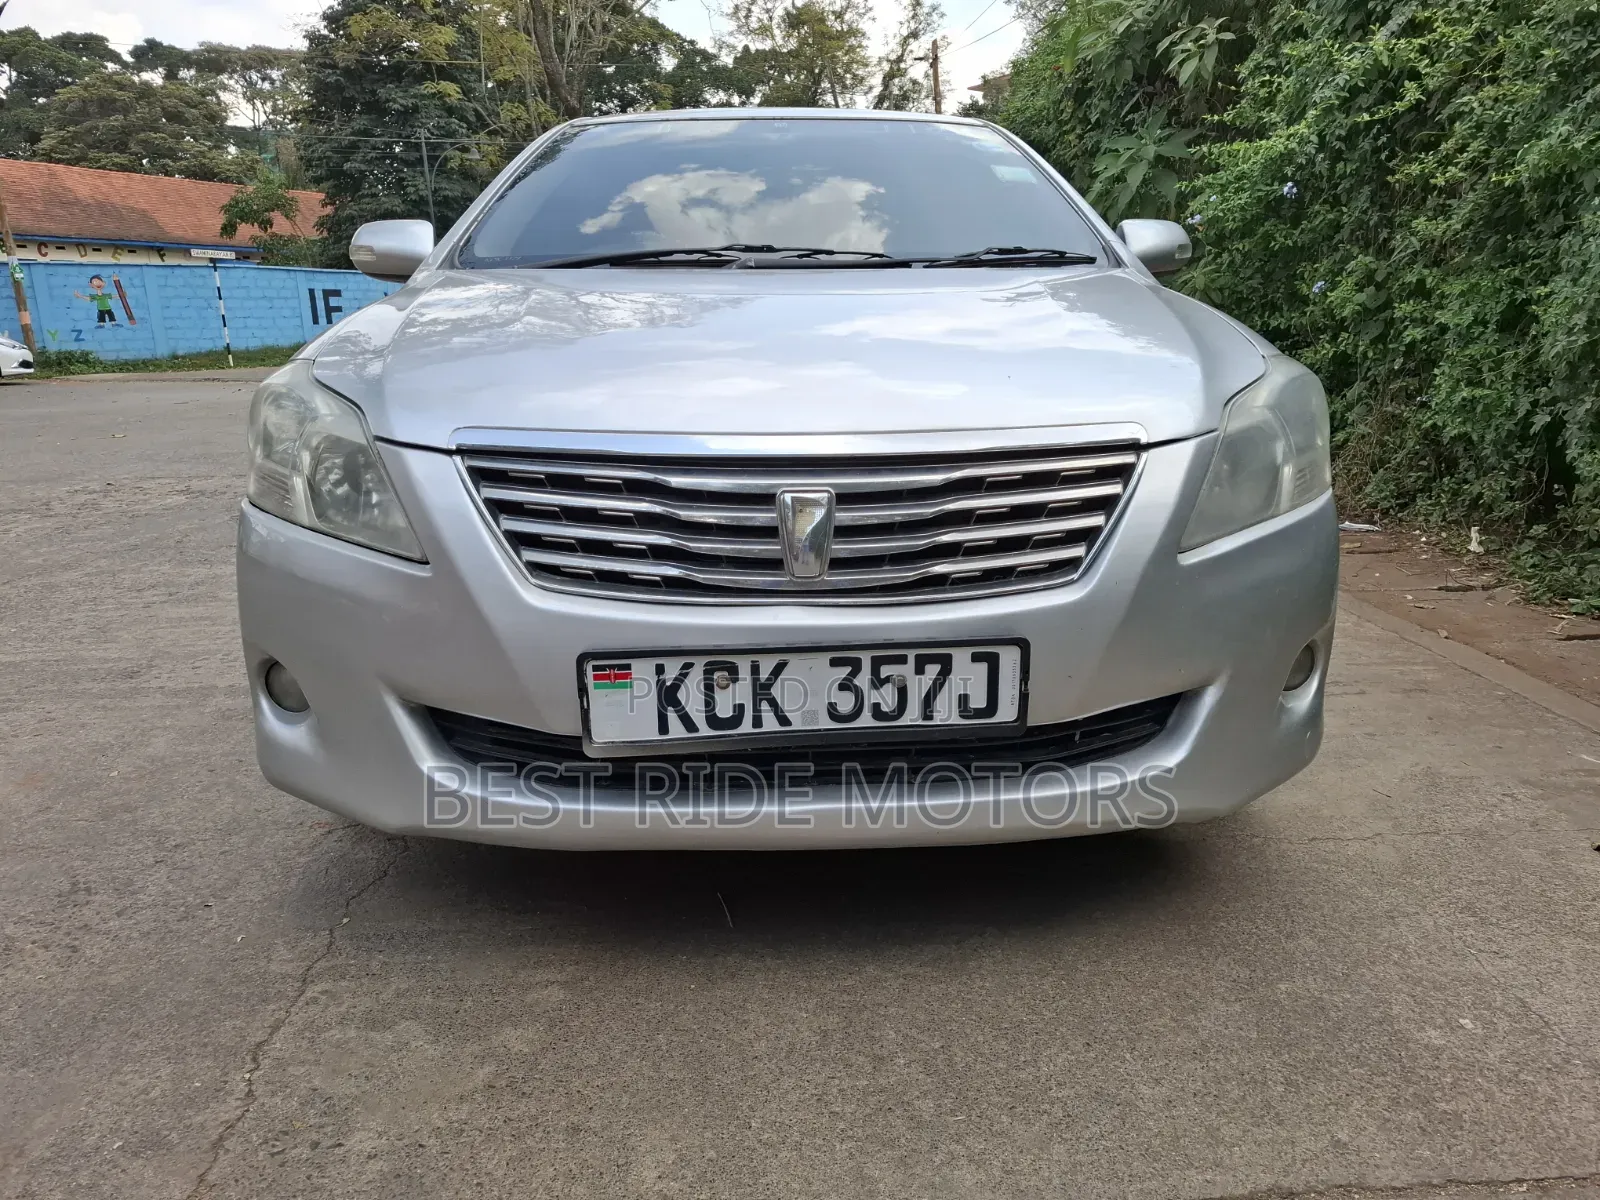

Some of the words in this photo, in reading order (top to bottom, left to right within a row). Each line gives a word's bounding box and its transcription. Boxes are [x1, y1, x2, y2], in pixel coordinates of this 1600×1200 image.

[36, 241, 49, 258] C
[75, 243, 88, 259] D
[111, 244, 125, 262] E
[156, 247, 167, 263] F
[308, 288, 343, 325] IF
[46, 328, 59, 341] Y
[71, 329, 85, 342] Z
[655, 659, 792, 735] KCK
[827, 651, 1000, 723] 357J
